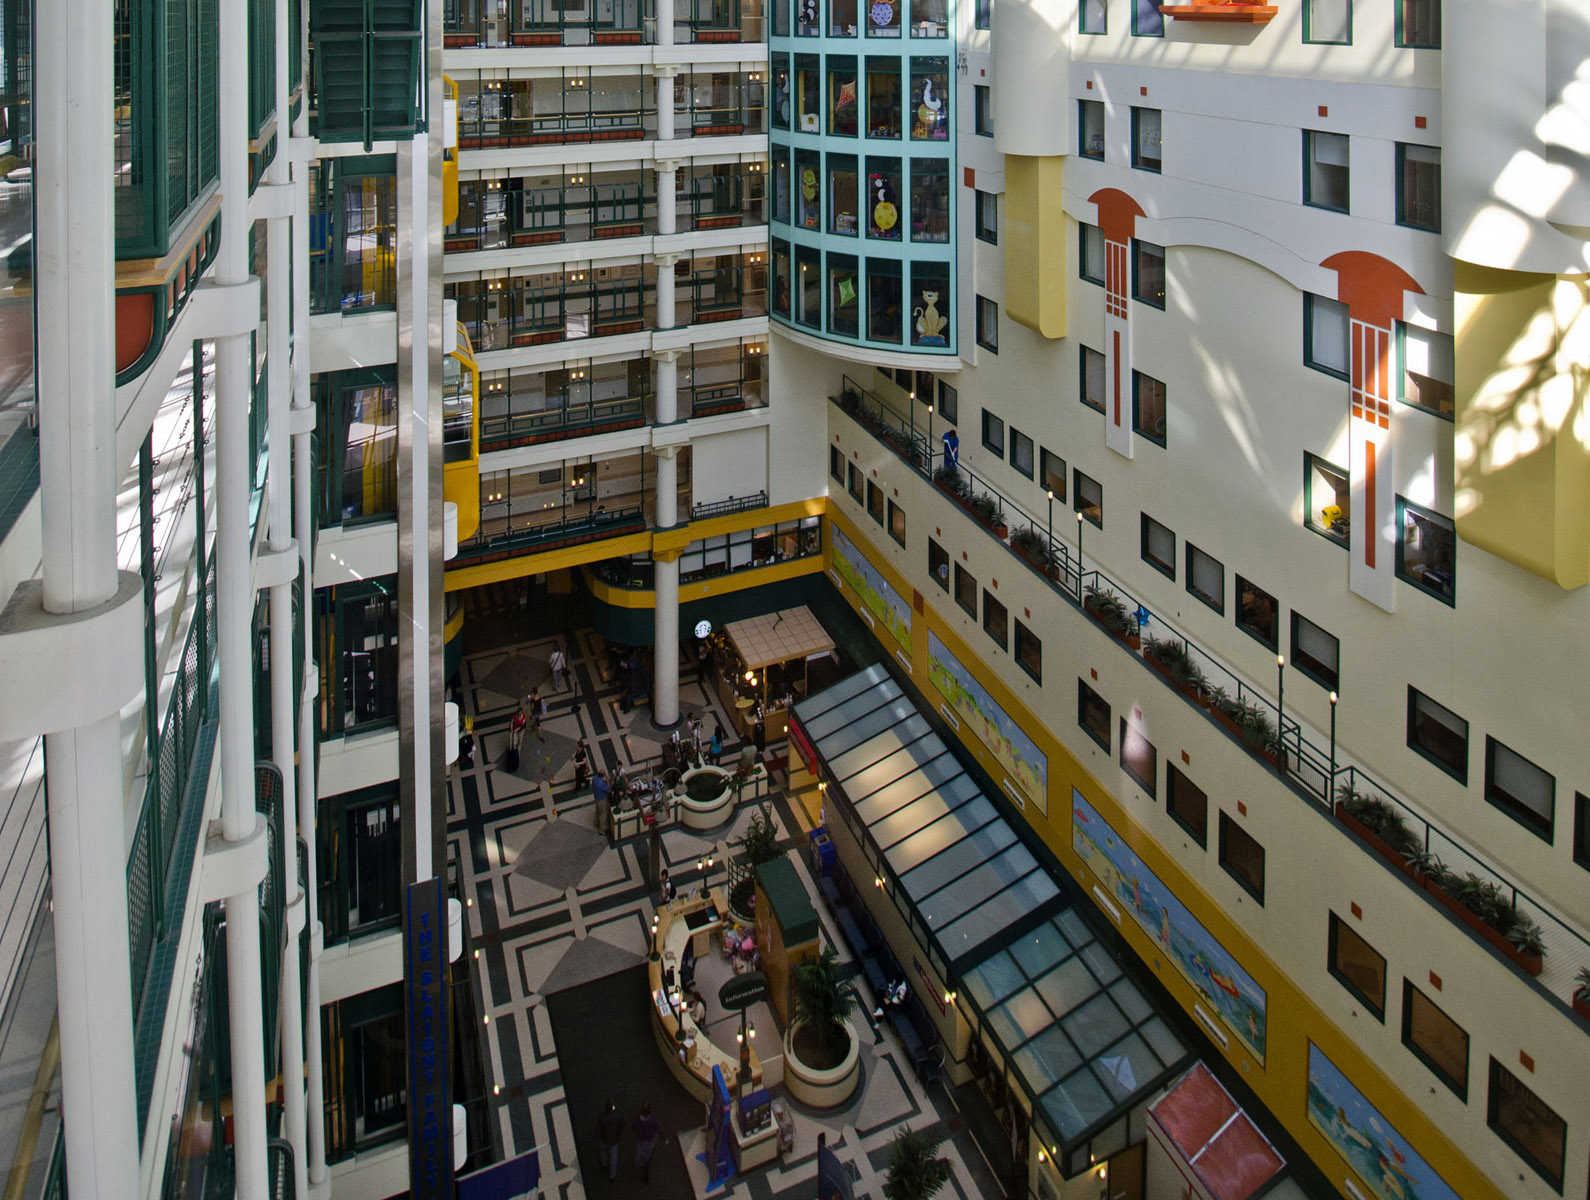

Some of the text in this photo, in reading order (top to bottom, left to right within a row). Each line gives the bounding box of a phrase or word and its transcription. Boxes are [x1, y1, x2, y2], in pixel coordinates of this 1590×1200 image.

[419, 912, 432, 963] THE
[420, 970, 435, 1084] SLAIGHT
[725, 985, 765, 1004] Information
[423, 1094, 438, 1189] FAMILY
